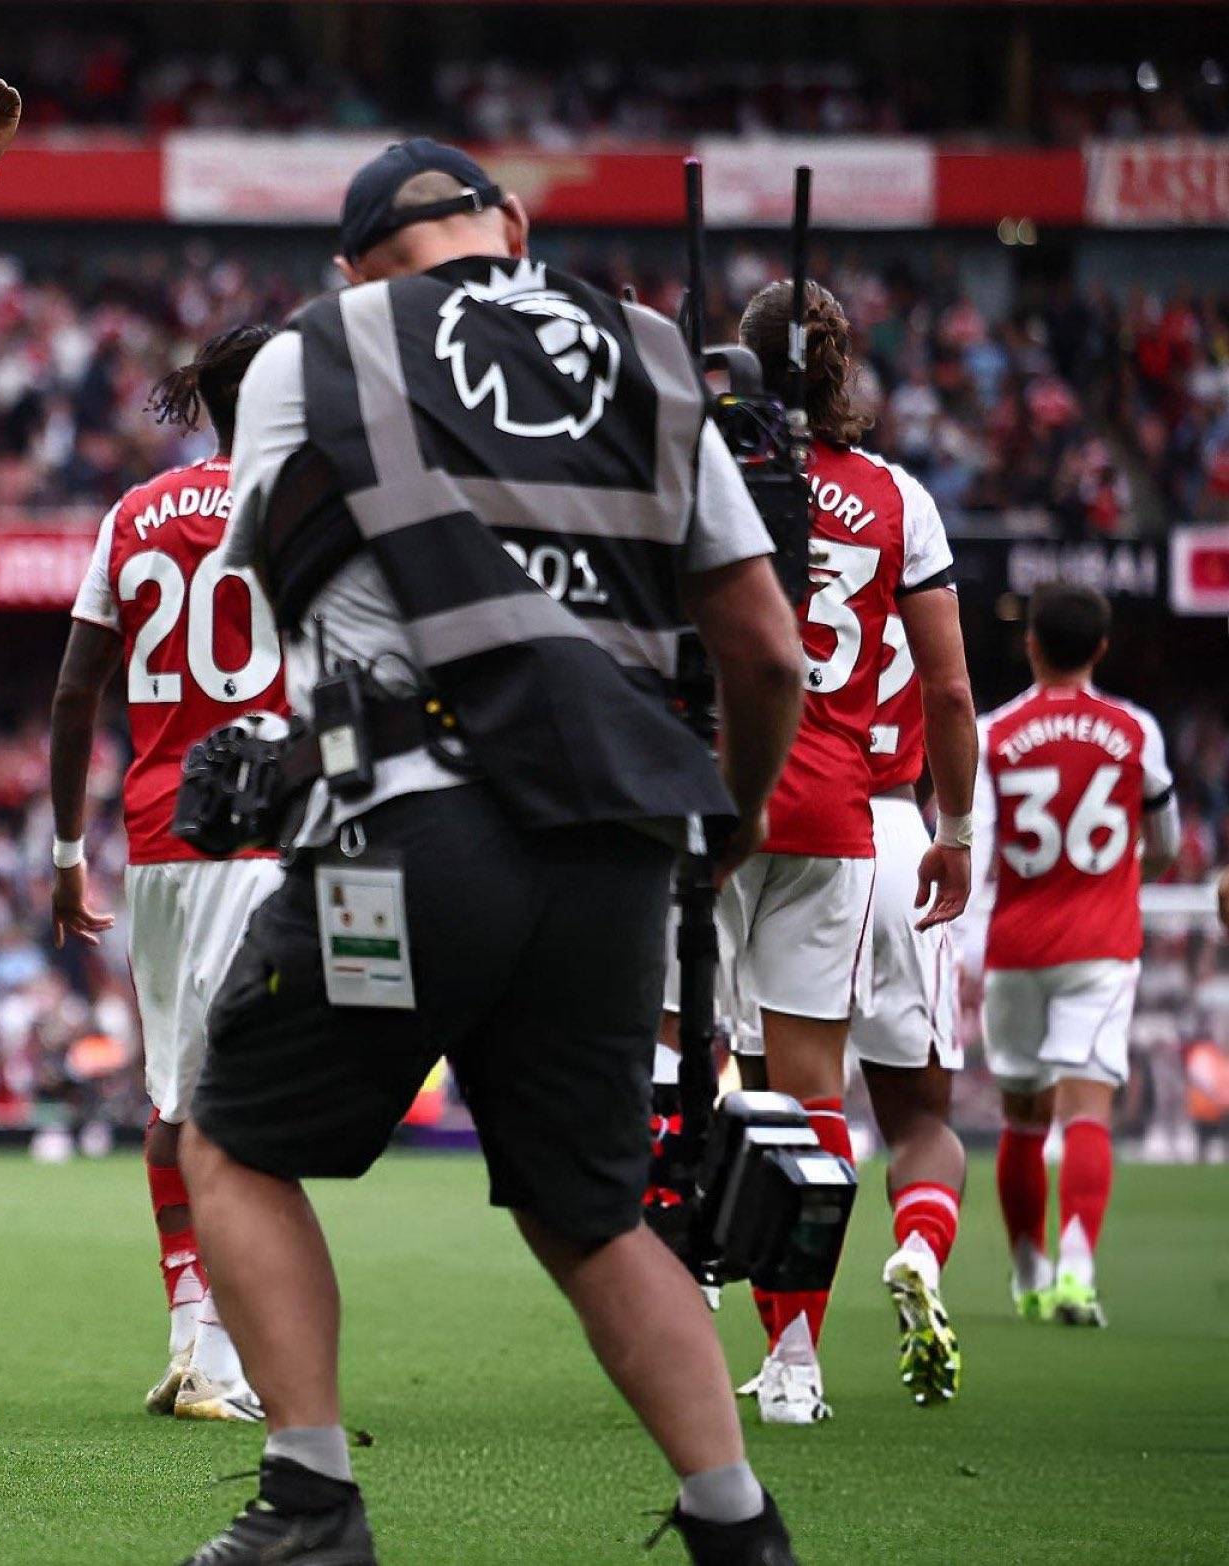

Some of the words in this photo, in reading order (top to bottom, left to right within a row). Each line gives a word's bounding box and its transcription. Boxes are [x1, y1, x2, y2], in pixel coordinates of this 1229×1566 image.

[133, 486, 233, 541] MADUE
[800, 473, 876, 534] IORI
[119, 550, 282, 702] 20
[998, 765, 1130, 879] 36
